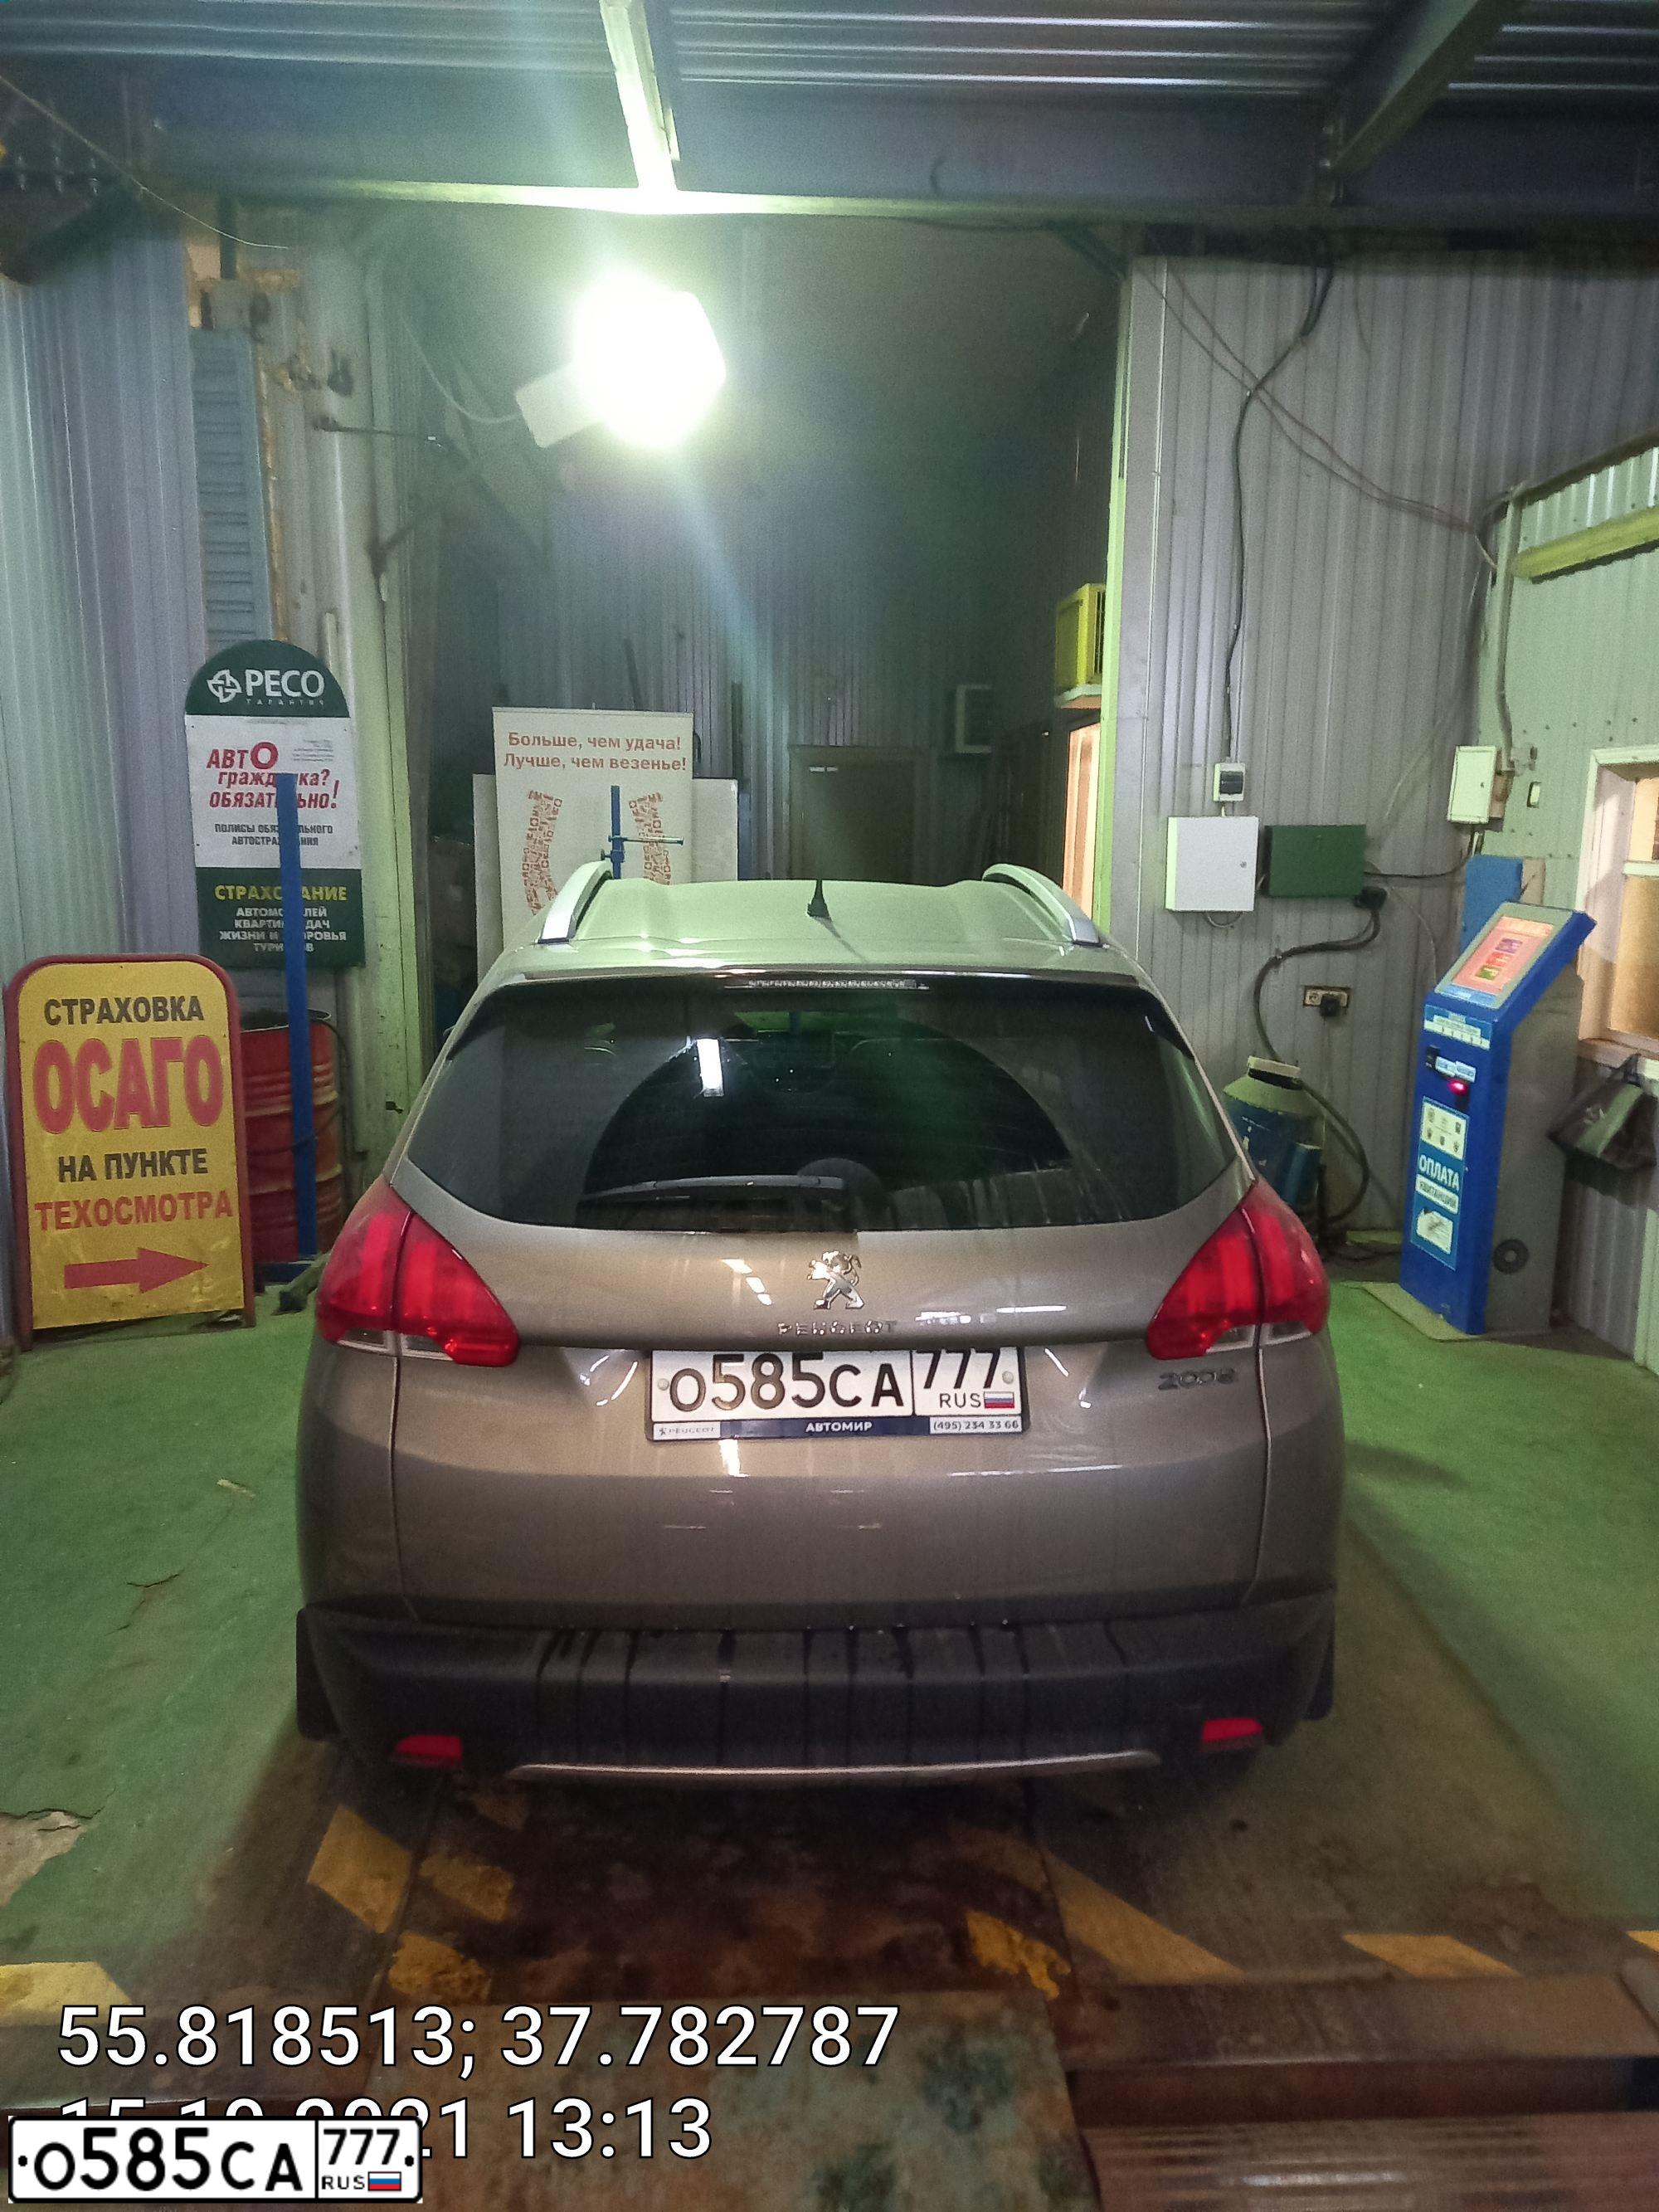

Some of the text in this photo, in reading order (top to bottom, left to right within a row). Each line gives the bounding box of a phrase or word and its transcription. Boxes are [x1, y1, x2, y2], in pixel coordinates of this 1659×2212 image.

[245, 670, 324, 697] РЕСО
[508, 732, 681, 751] Больше, чем удача!
[207, 742, 279, 769] АВТО
[504, 753, 687, 771] Лучше, чем везенье!
[218, 769, 330, 788] граждка?
[209, 780, 339, 810] ОБЯЗАТЬНО!
[215, 823, 255, 833] ПОЛИСЫ
[231, 836, 319, 845] АВТОСТРАНИЯ
[214, 884, 348, 901] СТРАХОАНИЕ
[236, 905, 328, 918] АВТОМОЛЕЙ
[234, 919, 330, 930] КВАРТИ ДАЧ
[220, 931, 265, 941] ЖИЗНИ
[44, 996, 205, 1026] СТРАХОВКА
[32, 1035, 224, 1134] ОСАГО
[58, 1148, 208, 1183] НА ПУНКТЕ
[1418, 1154, 1460, 1192] ОПЛАТА
[34, 1190, 233, 1231] ТЕХОСМОТРА
[915, 1348, 1000, 1390] 777
[939, 1392, 982, 1409] RUS
[805, 1420, 873, 1434] АВТОМИР
[933, 1420, 961, 1431] (495)
[965, 1420, 985, 1430] 234
[989, 1420, 1002, 1430] 33
